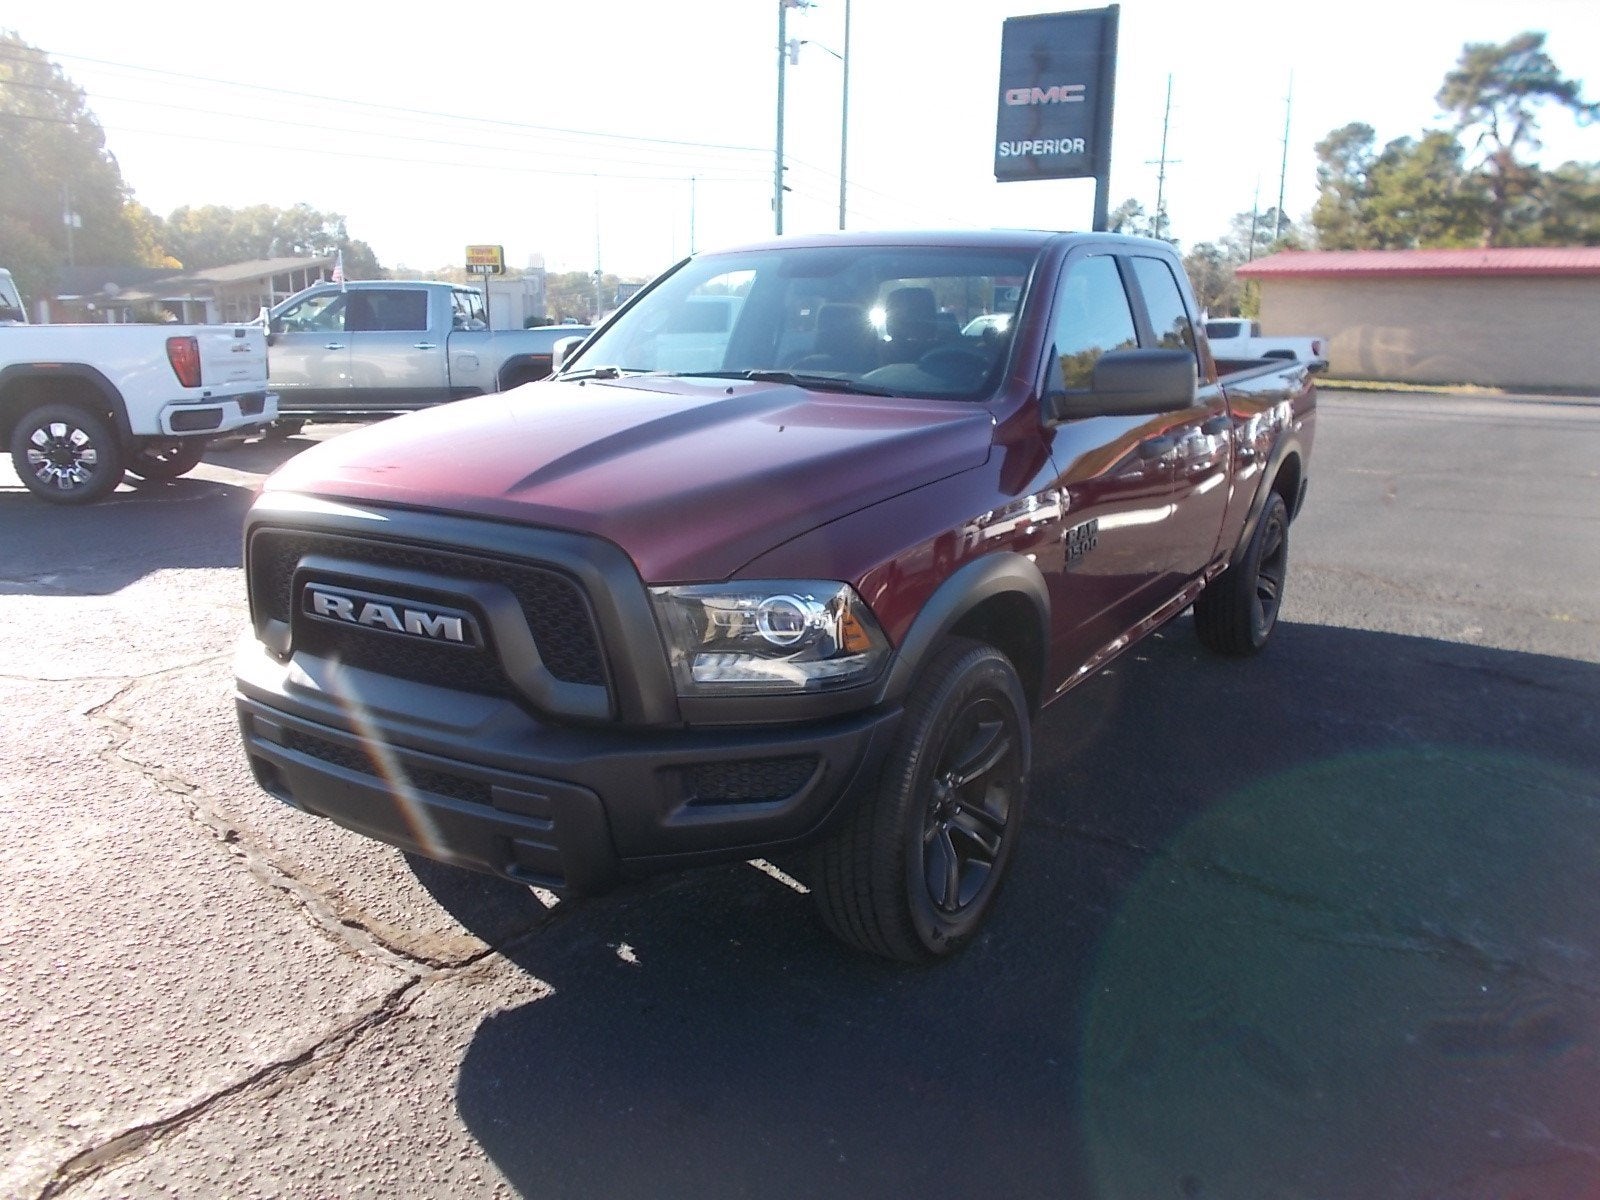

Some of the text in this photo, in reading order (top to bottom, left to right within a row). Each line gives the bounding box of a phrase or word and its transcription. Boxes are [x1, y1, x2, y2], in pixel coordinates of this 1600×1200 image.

[1005, 85, 1086, 105] GMC
[999, 138, 1085, 156] SUPERIOR
[1066, 519, 1099, 547] RAM
[1066, 536, 1099, 560] 1500
[313, 591, 464, 642] RAM
